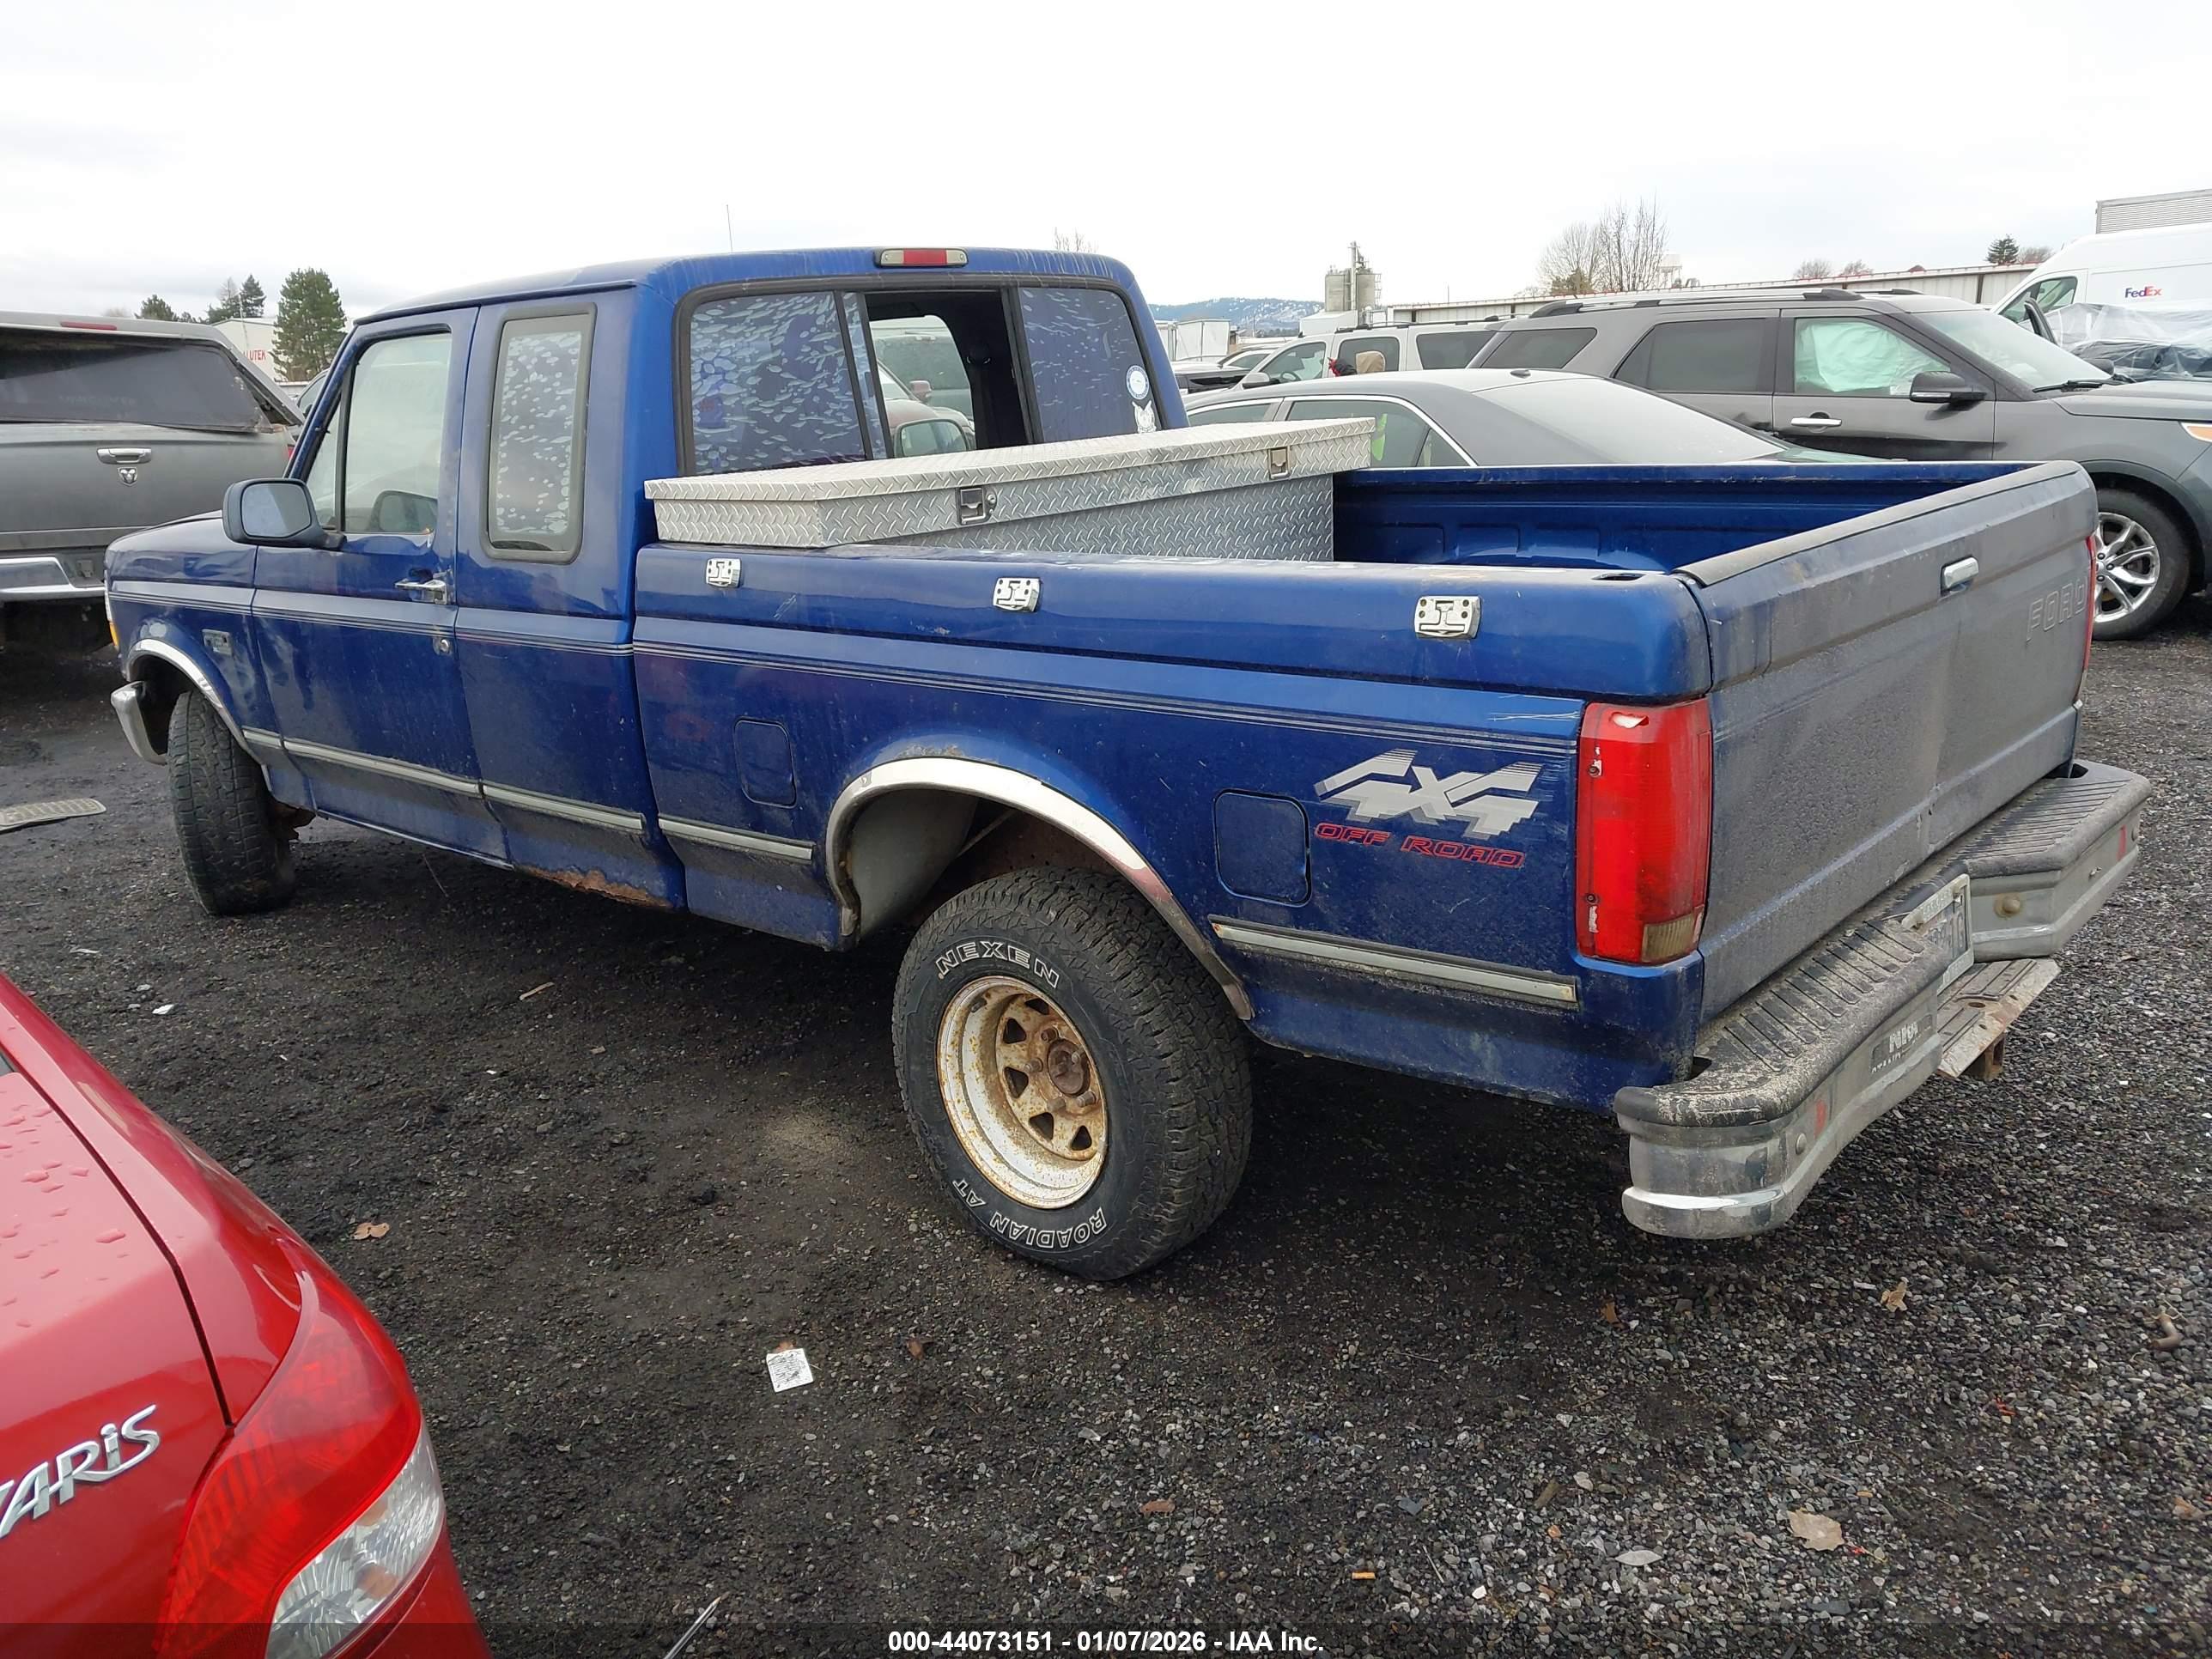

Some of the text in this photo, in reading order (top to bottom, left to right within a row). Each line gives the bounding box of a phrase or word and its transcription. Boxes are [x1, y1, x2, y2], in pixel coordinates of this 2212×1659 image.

[2124, 286, 2163, 298] FedEx
[2027, 576, 2087, 644] FORD
[1314, 822, 1525, 868] OFF ROAD
[935, 940, 1060, 988] NEXEN
[952, 1177, 1108, 1249] ROADIAN AT
